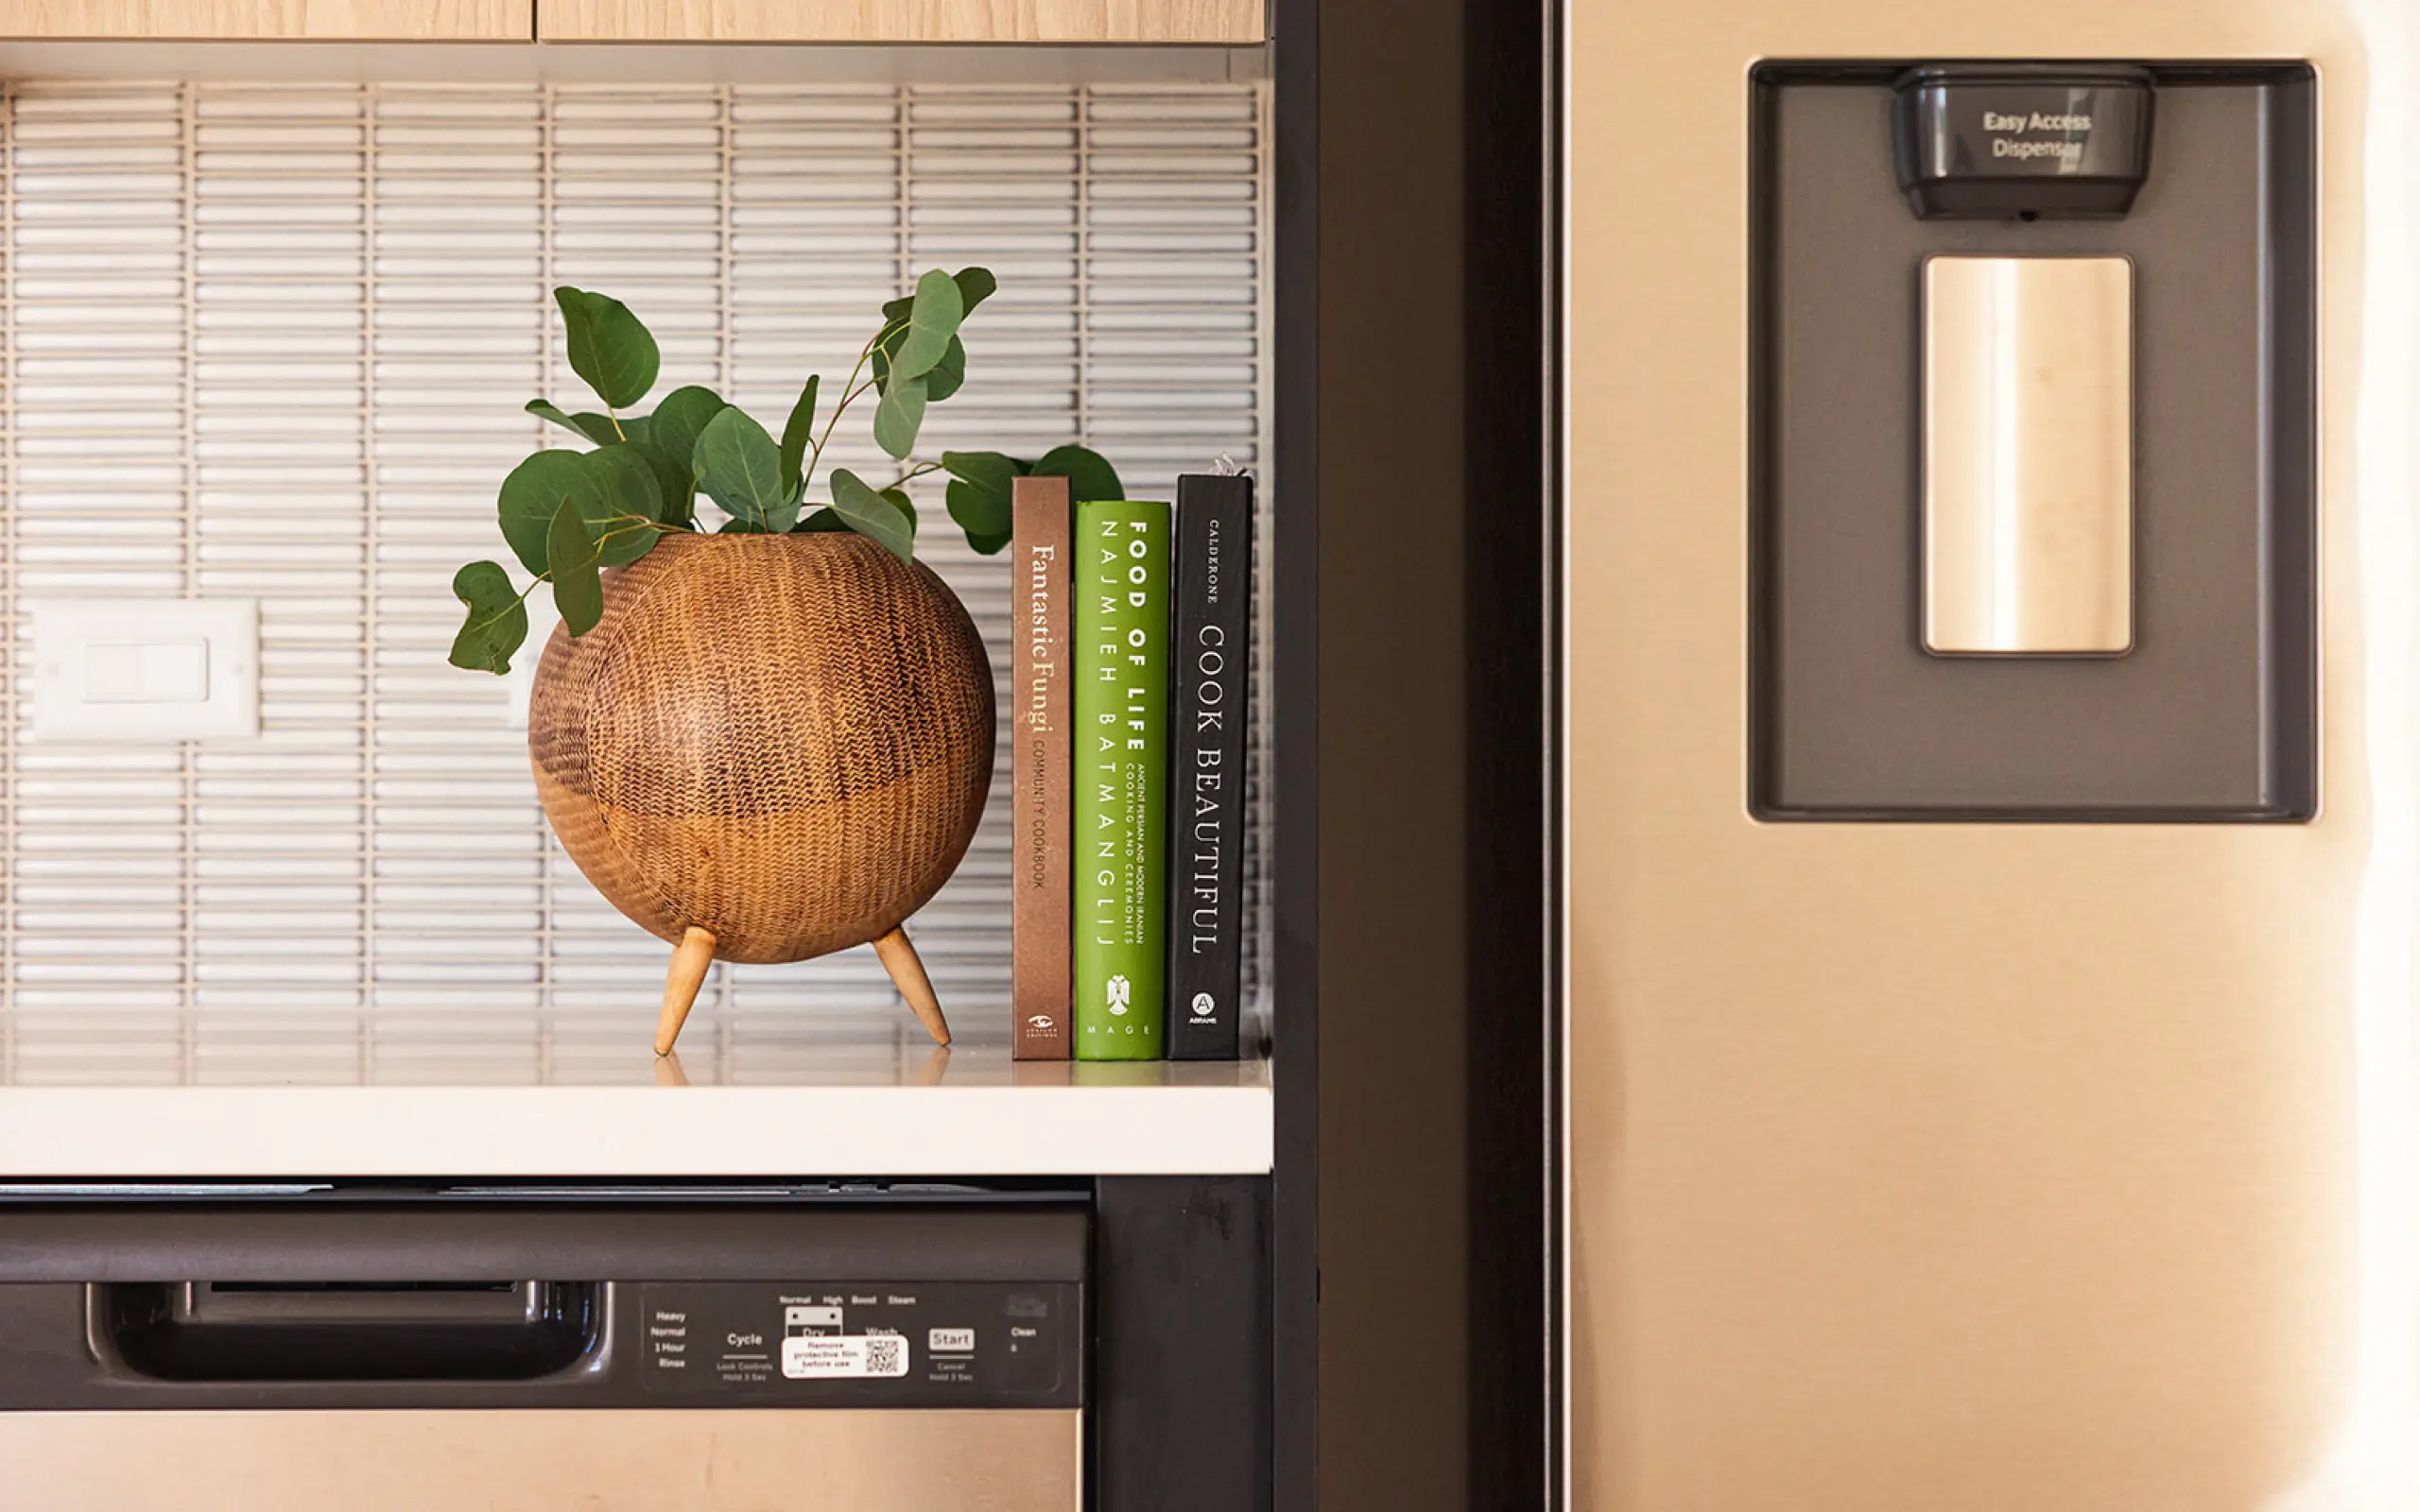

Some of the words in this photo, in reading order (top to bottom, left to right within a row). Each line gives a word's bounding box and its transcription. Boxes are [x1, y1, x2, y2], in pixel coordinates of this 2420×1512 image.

[1983, 112, 2028, 134] Easy
[2029, 112, 2092, 130] Access
[1992, 138, 2083, 160] Dispenser
[1128, 522, 1147, 608] FOOD
[1207, 520, 1220, 604] CALDERONE
[1031, 544, 1054, 659] Fantastic
[1099, 521, 1119, 681] NAJMIEH
[1128, 628, 1146, 666] OF
[1197, 625, 1225, 731] COOK
[1028, 662, 1054, 733] Fungi
[1127, 688, 1146, 750] LIFE
[1032, 739, 1046, 816] COMMUNITY
[1126, 763, 1134, 823] COOKING
[1136, 764, 1146, 802] ANCIENT
[1097, 713, 1116, 945] BATMANGLIJ
[1136, 804, 1146, 841] PERSIAN
[1032, 819, 1046, 889] COOKBOOK
[1125, 831, 1133, 857] AND
[1136, 843, 1146, 862] AND
[1192, 748, 1221, 954] BEAUTIFUL
[1136, 866, 1146, 903] MODERN
[1125, 864, 1133, 945] CEREMONIES
[656, 1312, 686, 1323] Heavy
[822, 1296, 843, 1306] High
[650, 1327, 686, 1337] Normal
[662, 1342, 685, 1352] Hour
[727, 1332, 763, 1348] Cycle
[933, 1332, 969, 1345] Start
[794, 1351, 838, 1360] protective
